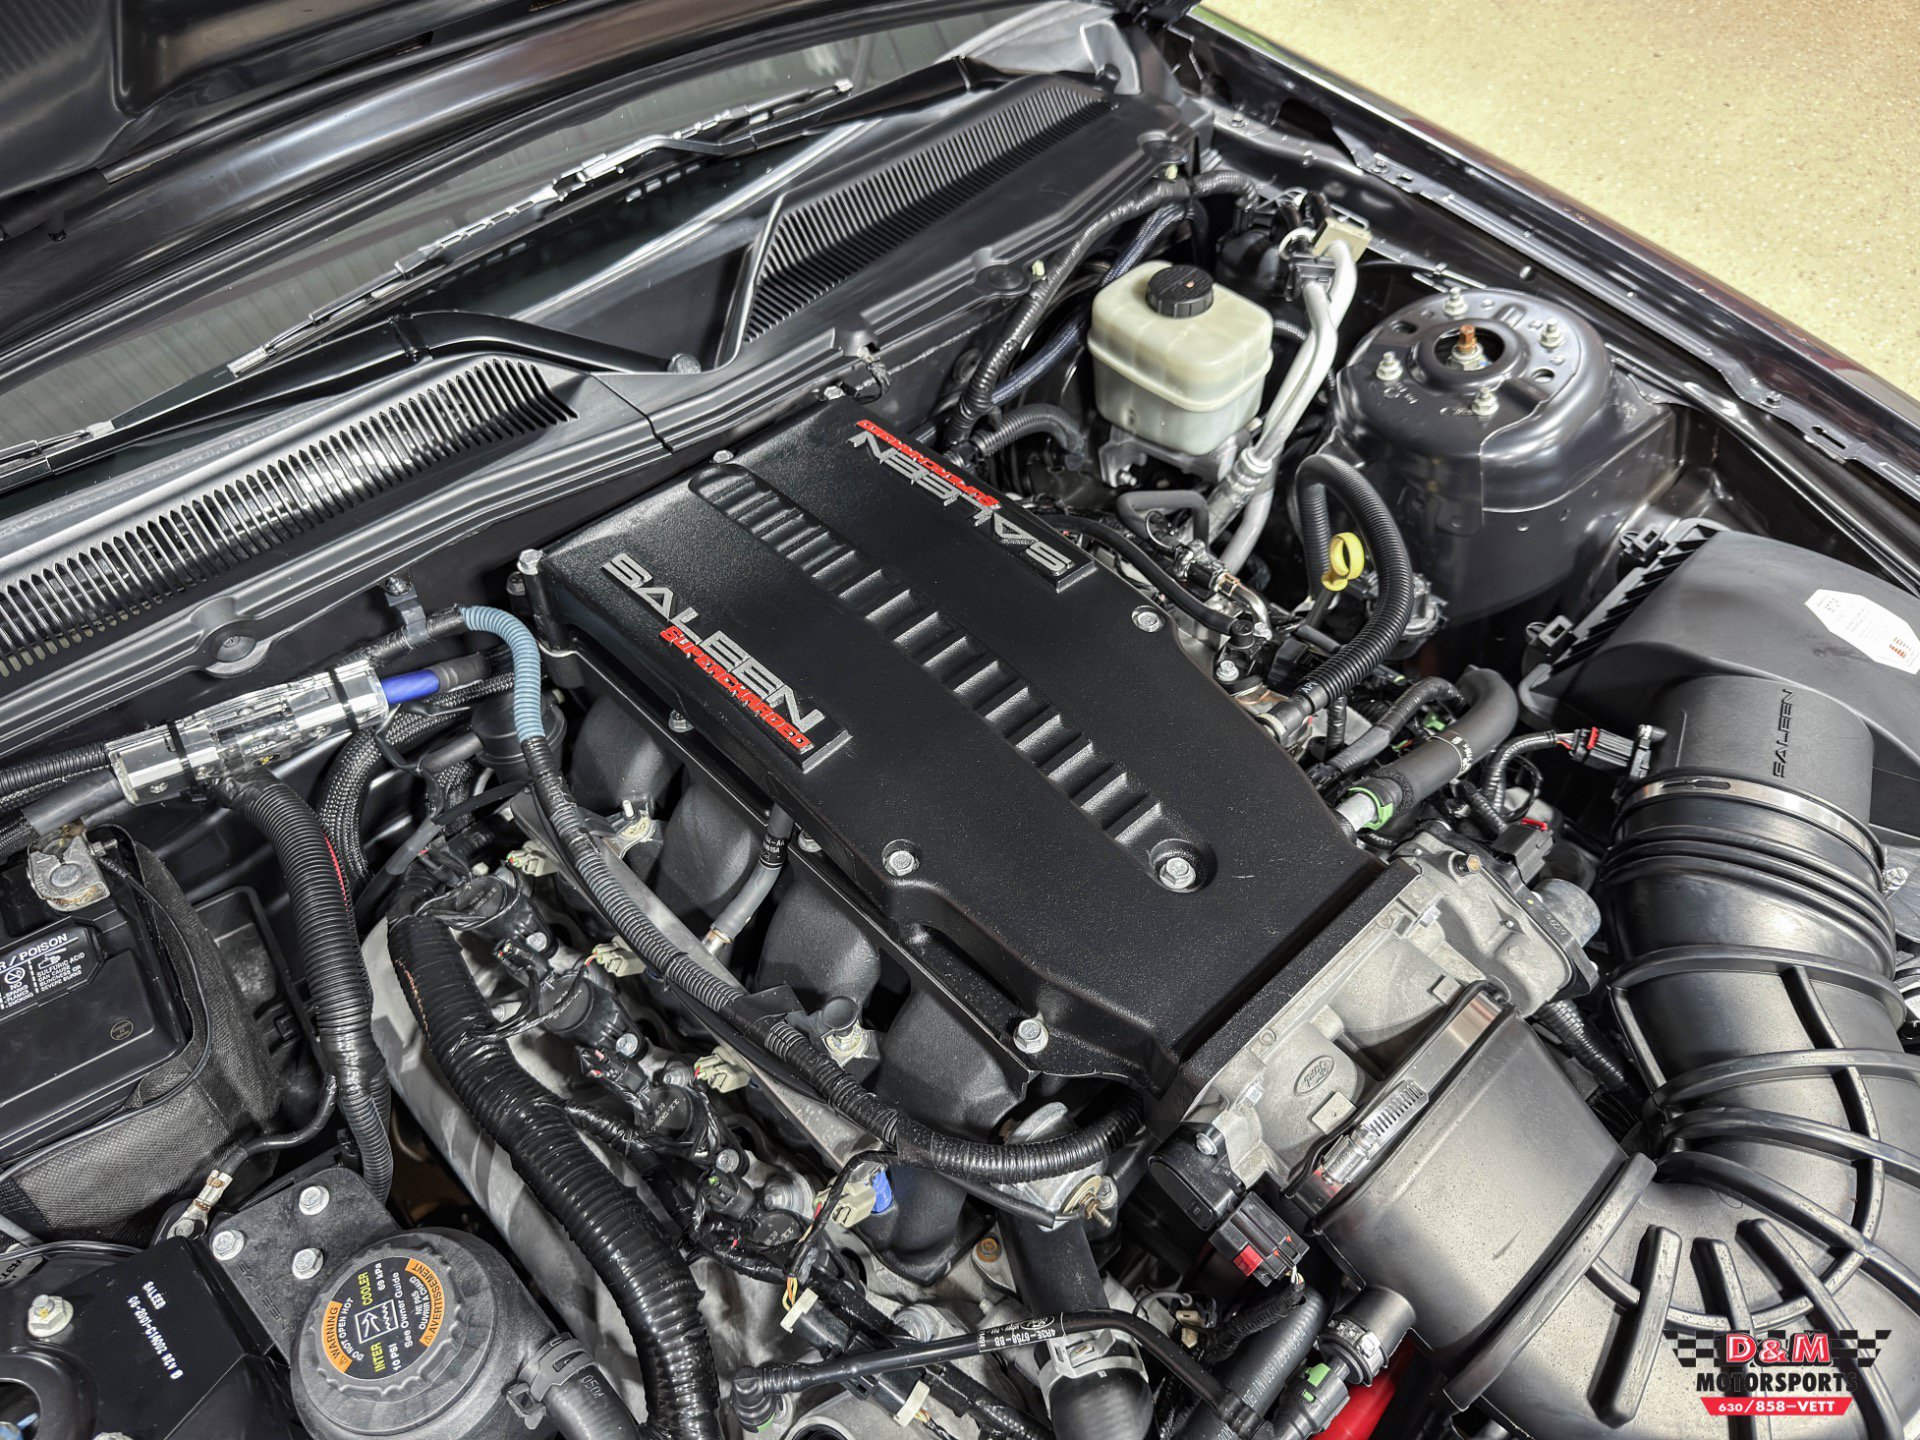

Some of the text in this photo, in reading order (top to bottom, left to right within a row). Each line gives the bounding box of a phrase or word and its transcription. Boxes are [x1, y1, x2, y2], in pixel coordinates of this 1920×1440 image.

[848, 431, 1075, 577] SALEEN
[601, 553, 827, 734] SALEEN
[659, 625, 815, 755] SUPERCHARGED
[1773, 688, 1795, 779] SALEEN
[19, 933, 69, 961] POISON
[36, 952, 86, 978] SULFURIC ACID
[38, 965, 72, 983] CAN CAUSE
[39, 970, 72, 988] BLINDNESS
[10, 981, 23, 991] NO
[376, 1281, 386, 1291] 69
[412, 1263, 444, 1335] AVERTISSEMENT
[392, 1271, 413, 1348] See Owner Guide
[411, 1290, 423, 1315] NE PAS
[418, 1301, 431, 1330] OUVRIR
[326, 1306, 341, 1360] WARNING
[337, 1297, 364, 1362] DO NOT OPEN HOT
[357, 1271, 386, 1372] INTER COOLER
[161, 1353, 177, 1371] REV
[388, 1342, 401, 1371] 10 PSI
